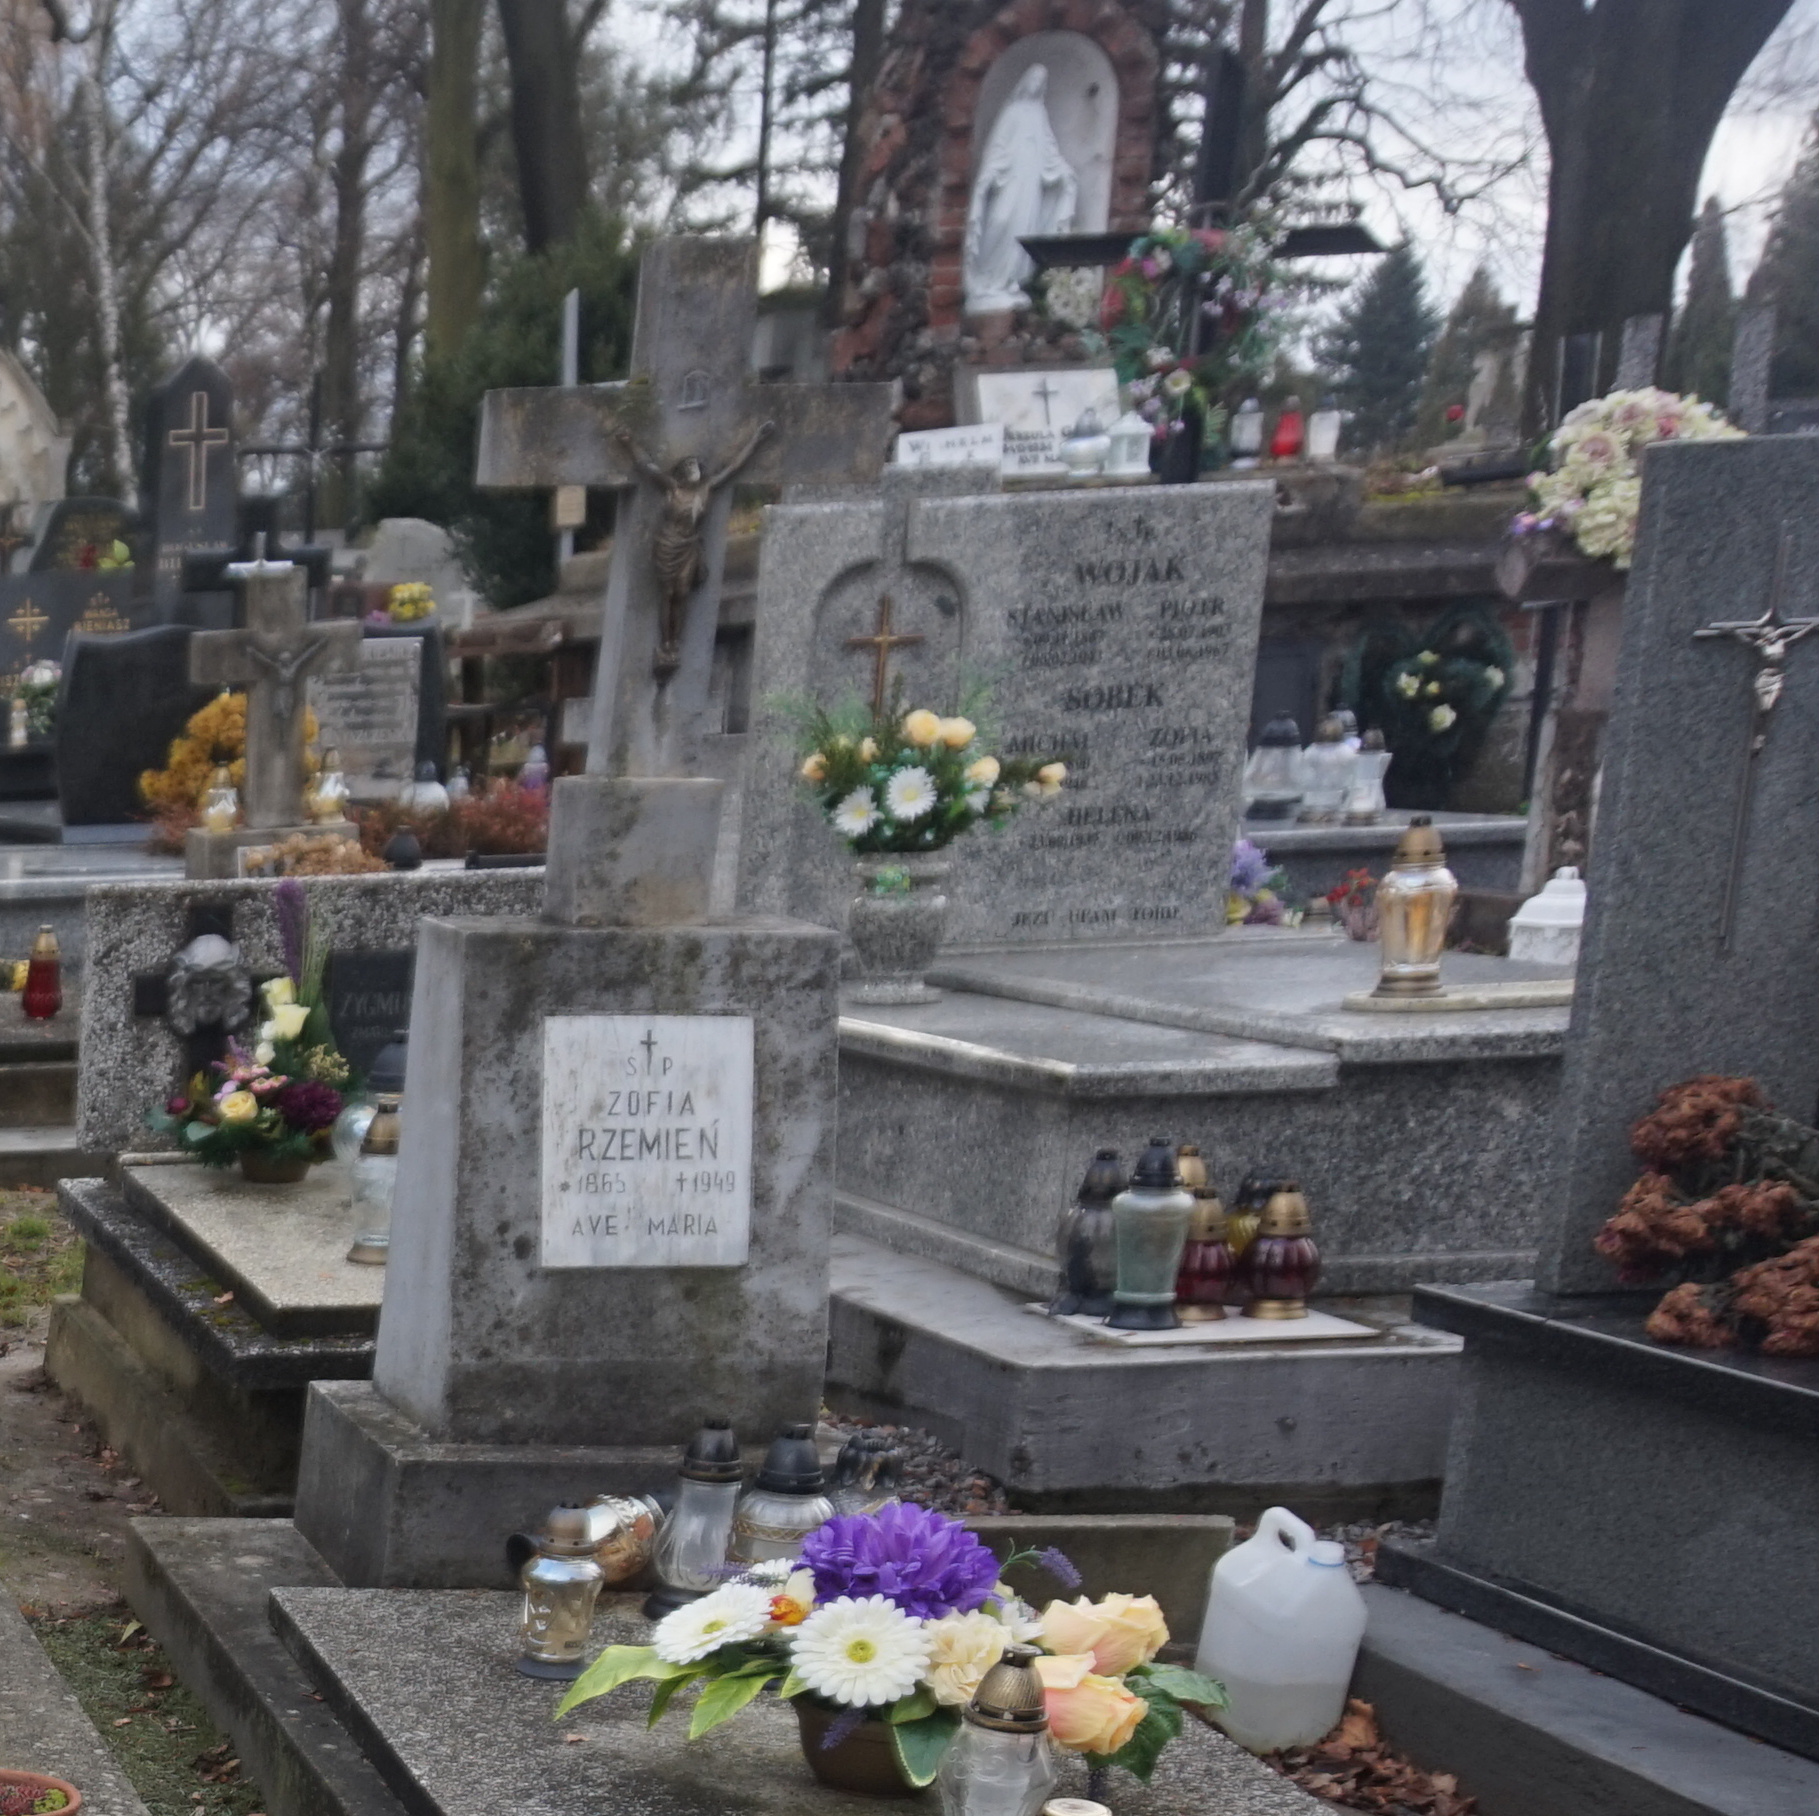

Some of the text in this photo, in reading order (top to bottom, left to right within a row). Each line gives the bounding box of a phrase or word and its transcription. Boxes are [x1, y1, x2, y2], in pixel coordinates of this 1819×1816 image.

[1075, 555, 1185, 586] WOJAK
[607, 1090, 696, 1117] ZOFIA
[577, 1118, 721, 1161] RZEMIEŃ
[571, 1213, 719, 1237] AVE MARIA
